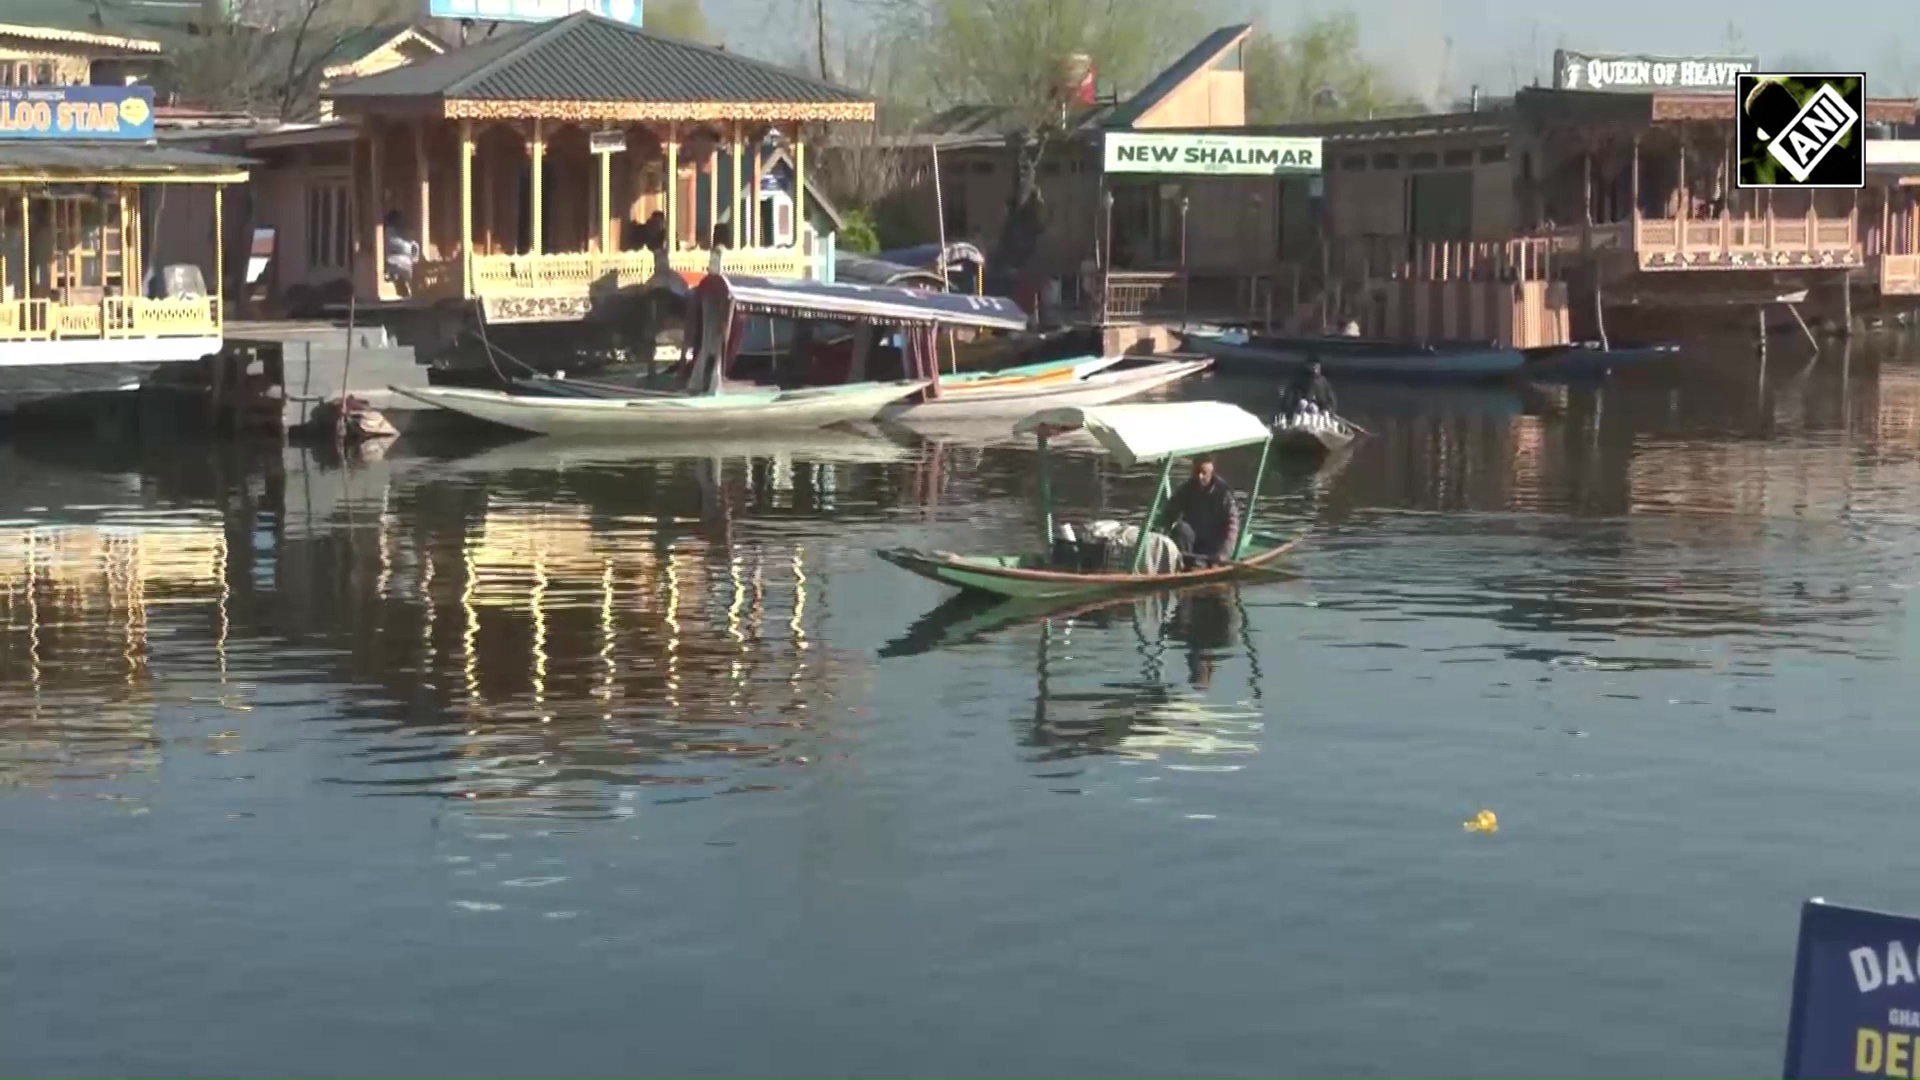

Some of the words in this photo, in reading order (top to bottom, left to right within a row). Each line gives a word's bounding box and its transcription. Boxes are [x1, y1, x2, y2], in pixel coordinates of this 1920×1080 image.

[1587, 59, 1650, 88] QUEEN
[1652, 63, 1677, 85] OF
[0, 101, 51, 131] LOO
[57, 102, 120, 132] STAR
[1117, 145, 1178, 162] NEW
[1184, 147, 1313, 165] SHALIMAR
[1849, 940, 1920, 993] DA
[1855, 1027, 1920, 1080] DE
